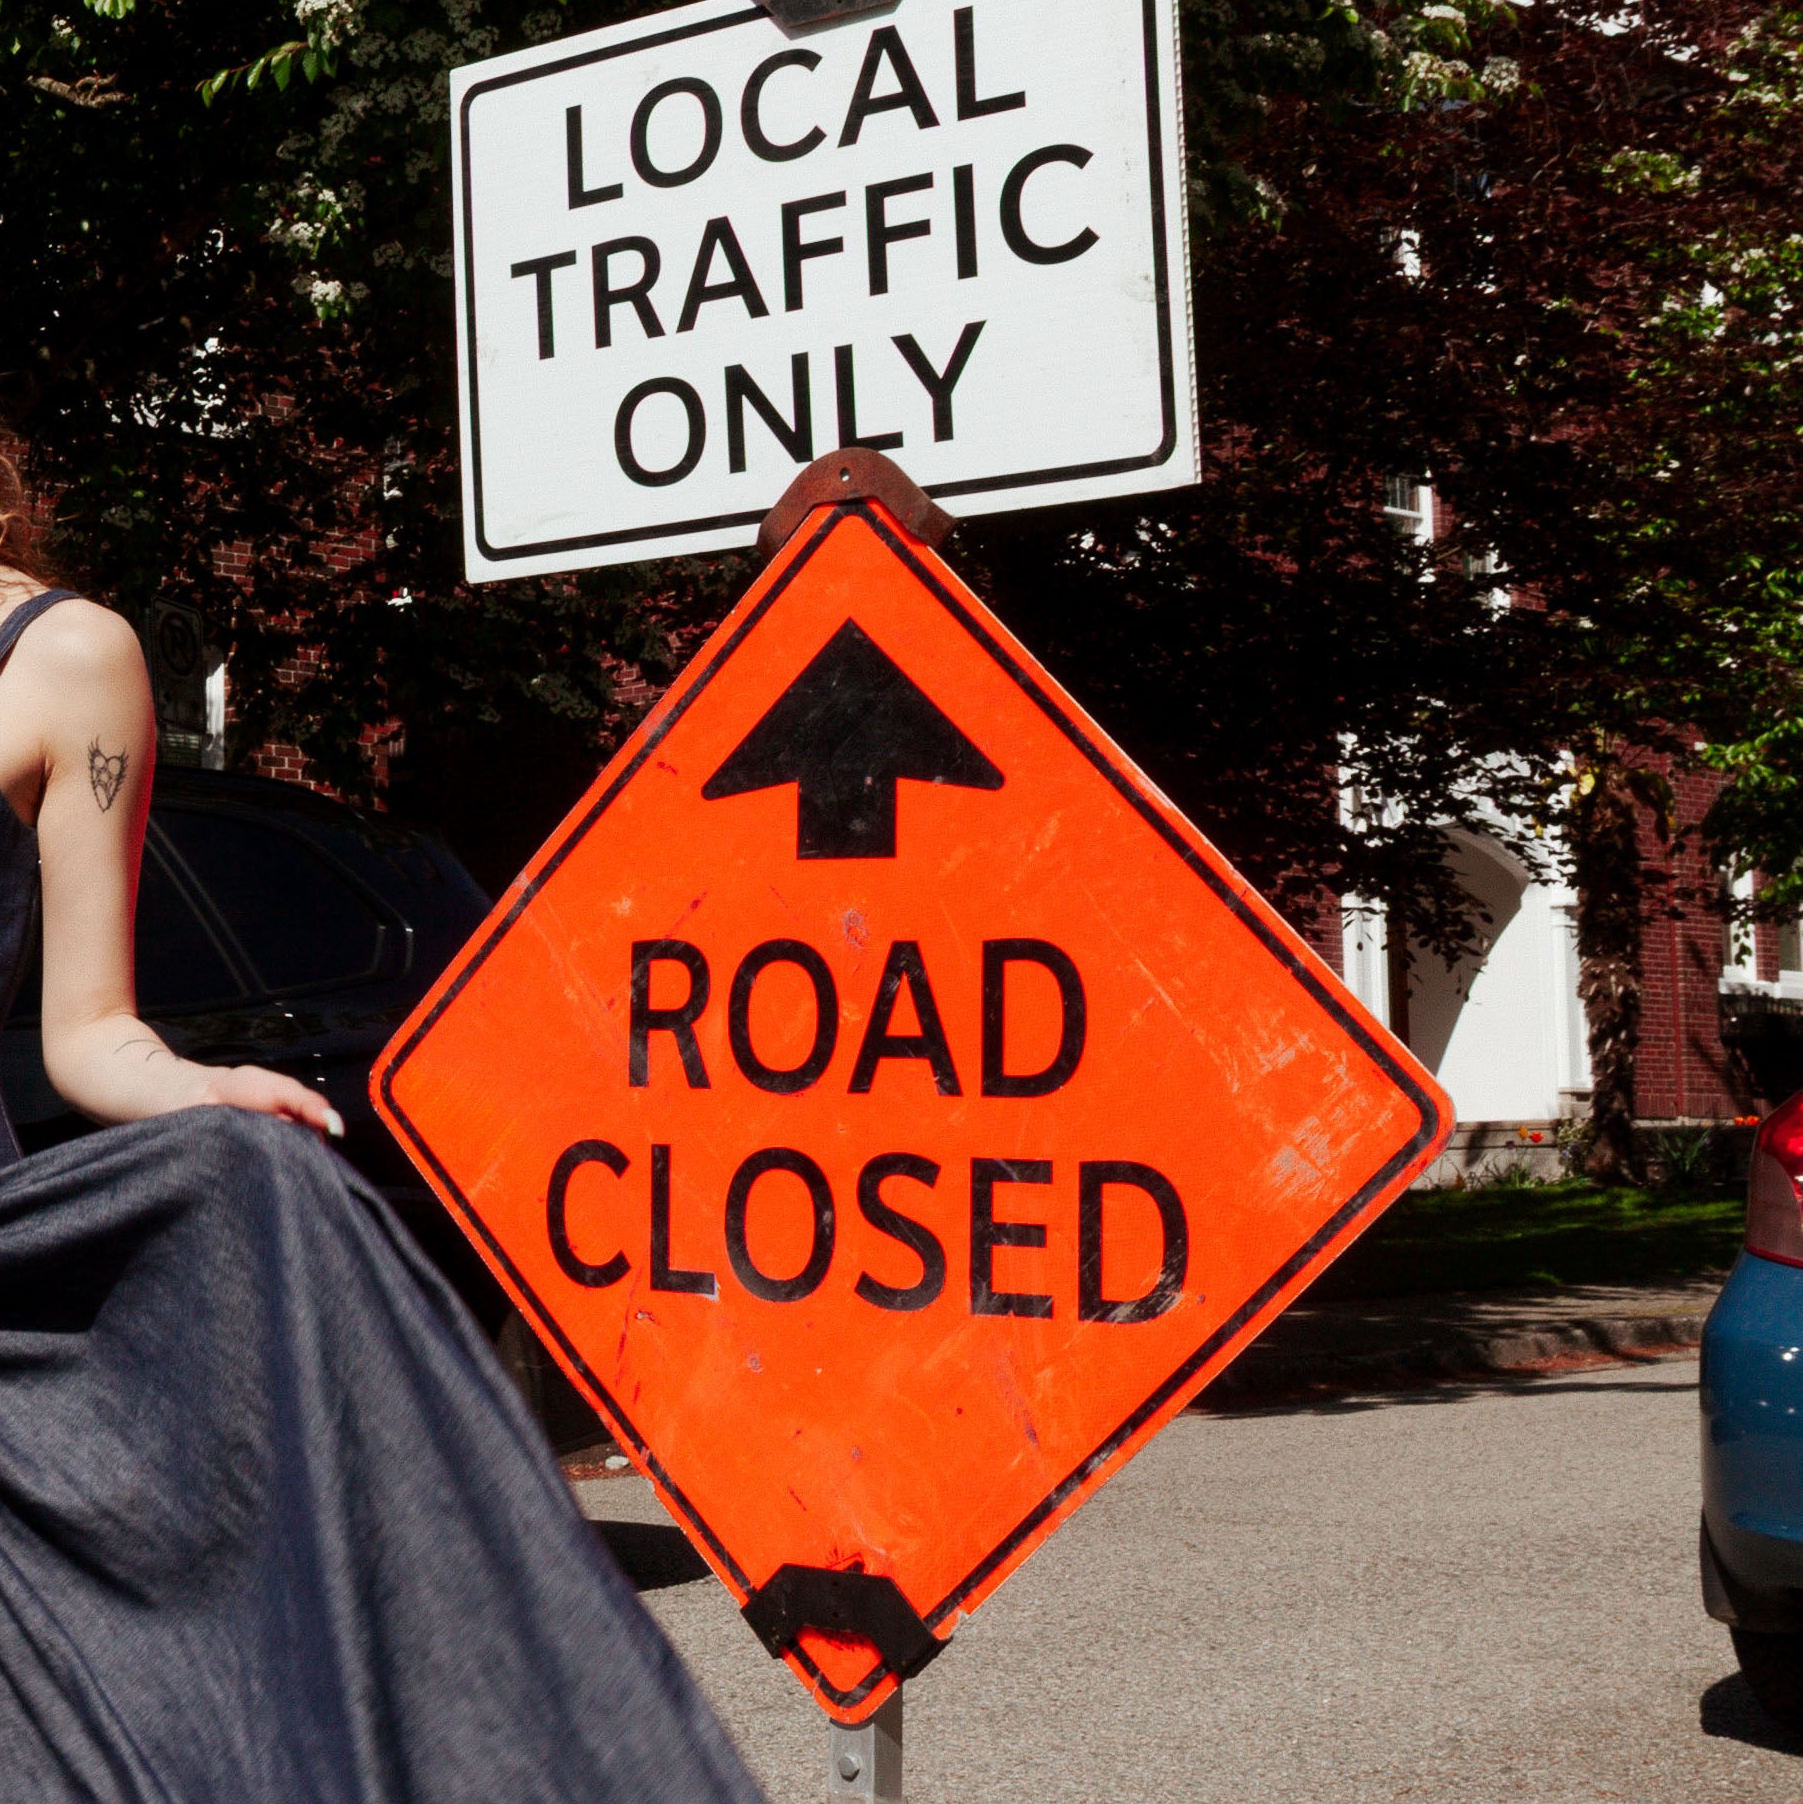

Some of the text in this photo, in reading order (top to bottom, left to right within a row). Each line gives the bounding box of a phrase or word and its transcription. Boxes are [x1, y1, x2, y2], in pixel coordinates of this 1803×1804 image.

[566, 5, 1026, 211] LOCAL
[510, 143, 1100, 361] TRAFFIC
[614, 320, 986, 488] ONLY
[629, 938, 1086, 1098] ROAD
[547, 1140, 1189, 1323] CLOSED
